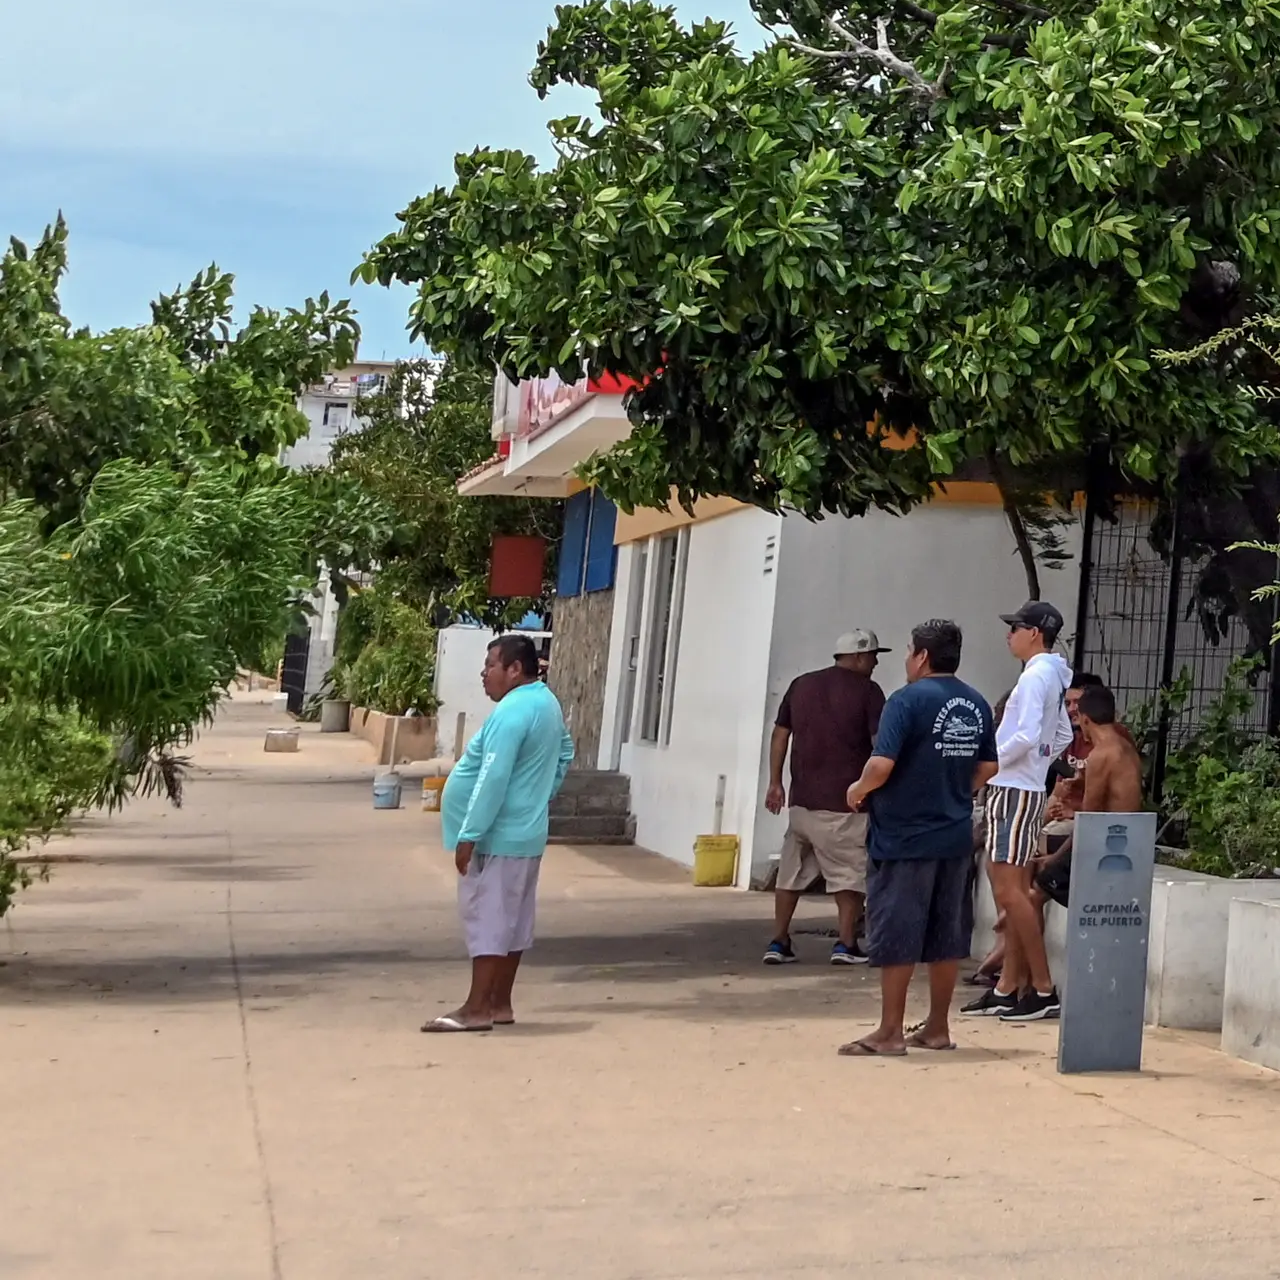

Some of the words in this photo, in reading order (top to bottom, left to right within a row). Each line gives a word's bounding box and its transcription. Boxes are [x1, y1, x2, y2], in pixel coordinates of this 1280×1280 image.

[932, 707, 949, 734] YATES
[1079, 917, 1098, 927] DEL
[1100, 916, 1143, 927] PUERTO
